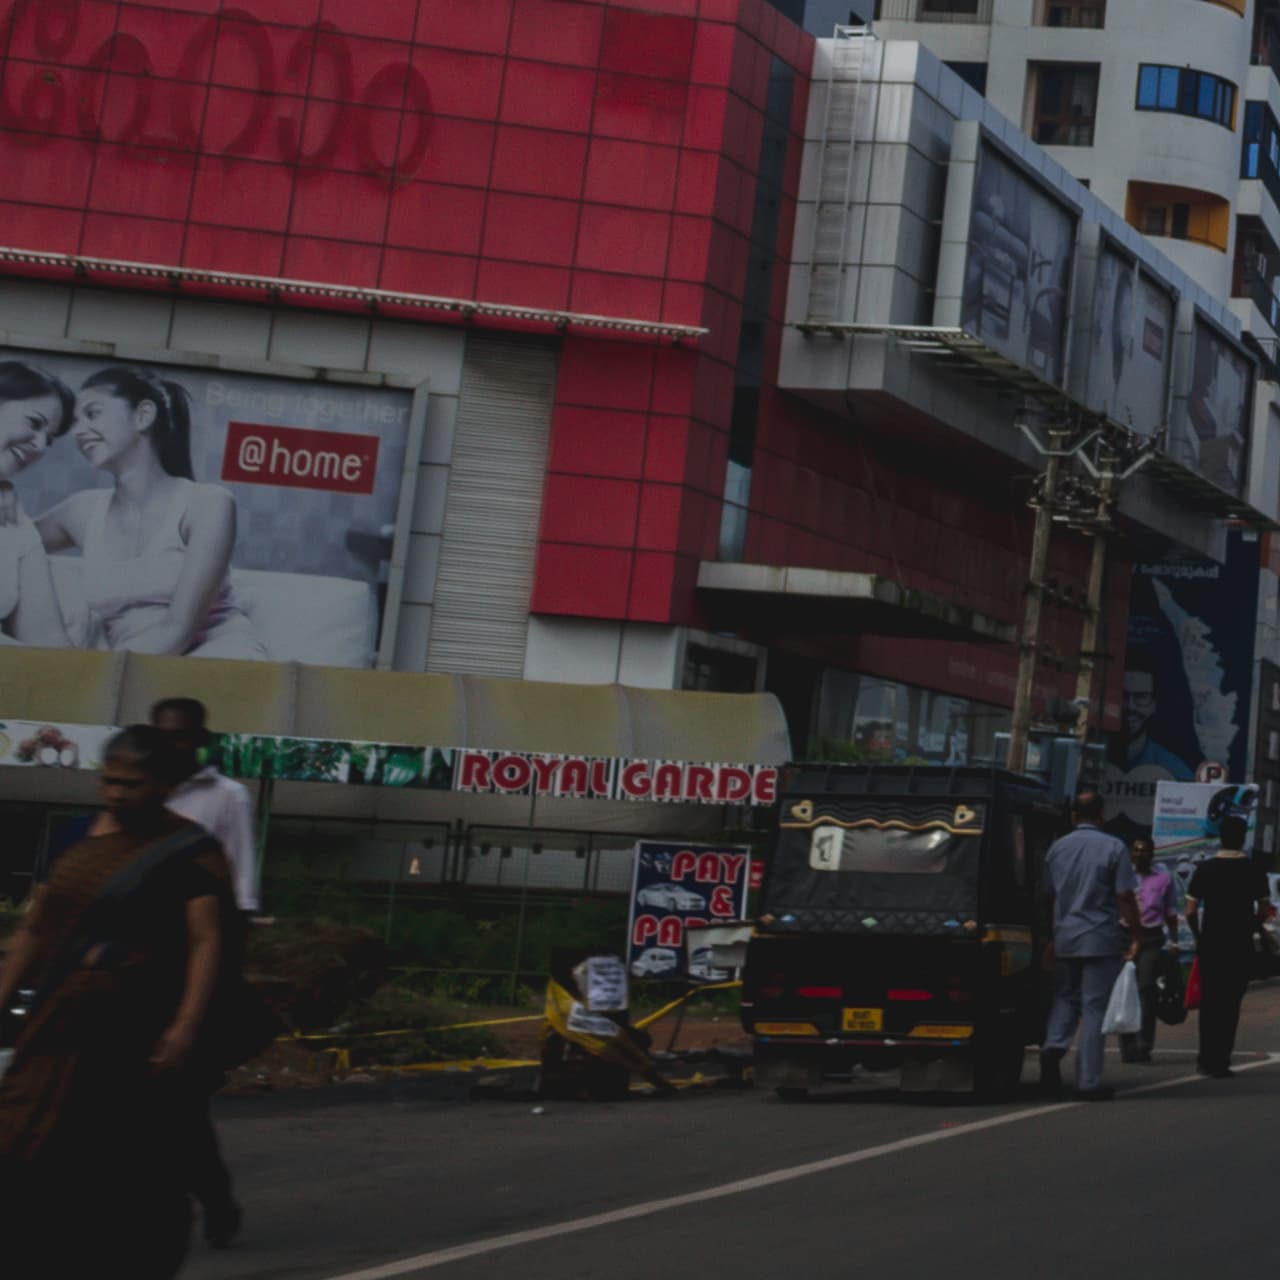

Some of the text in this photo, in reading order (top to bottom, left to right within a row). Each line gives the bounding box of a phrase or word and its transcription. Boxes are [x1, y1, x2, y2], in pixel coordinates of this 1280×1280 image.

[205, 380, 410, 425] Being together
[238, 435, 363, 481] @home
[461, 753, 608, 794] ROYAL
[671, 851, 746, 884] PAY
[709, 885, 736, 917] &
